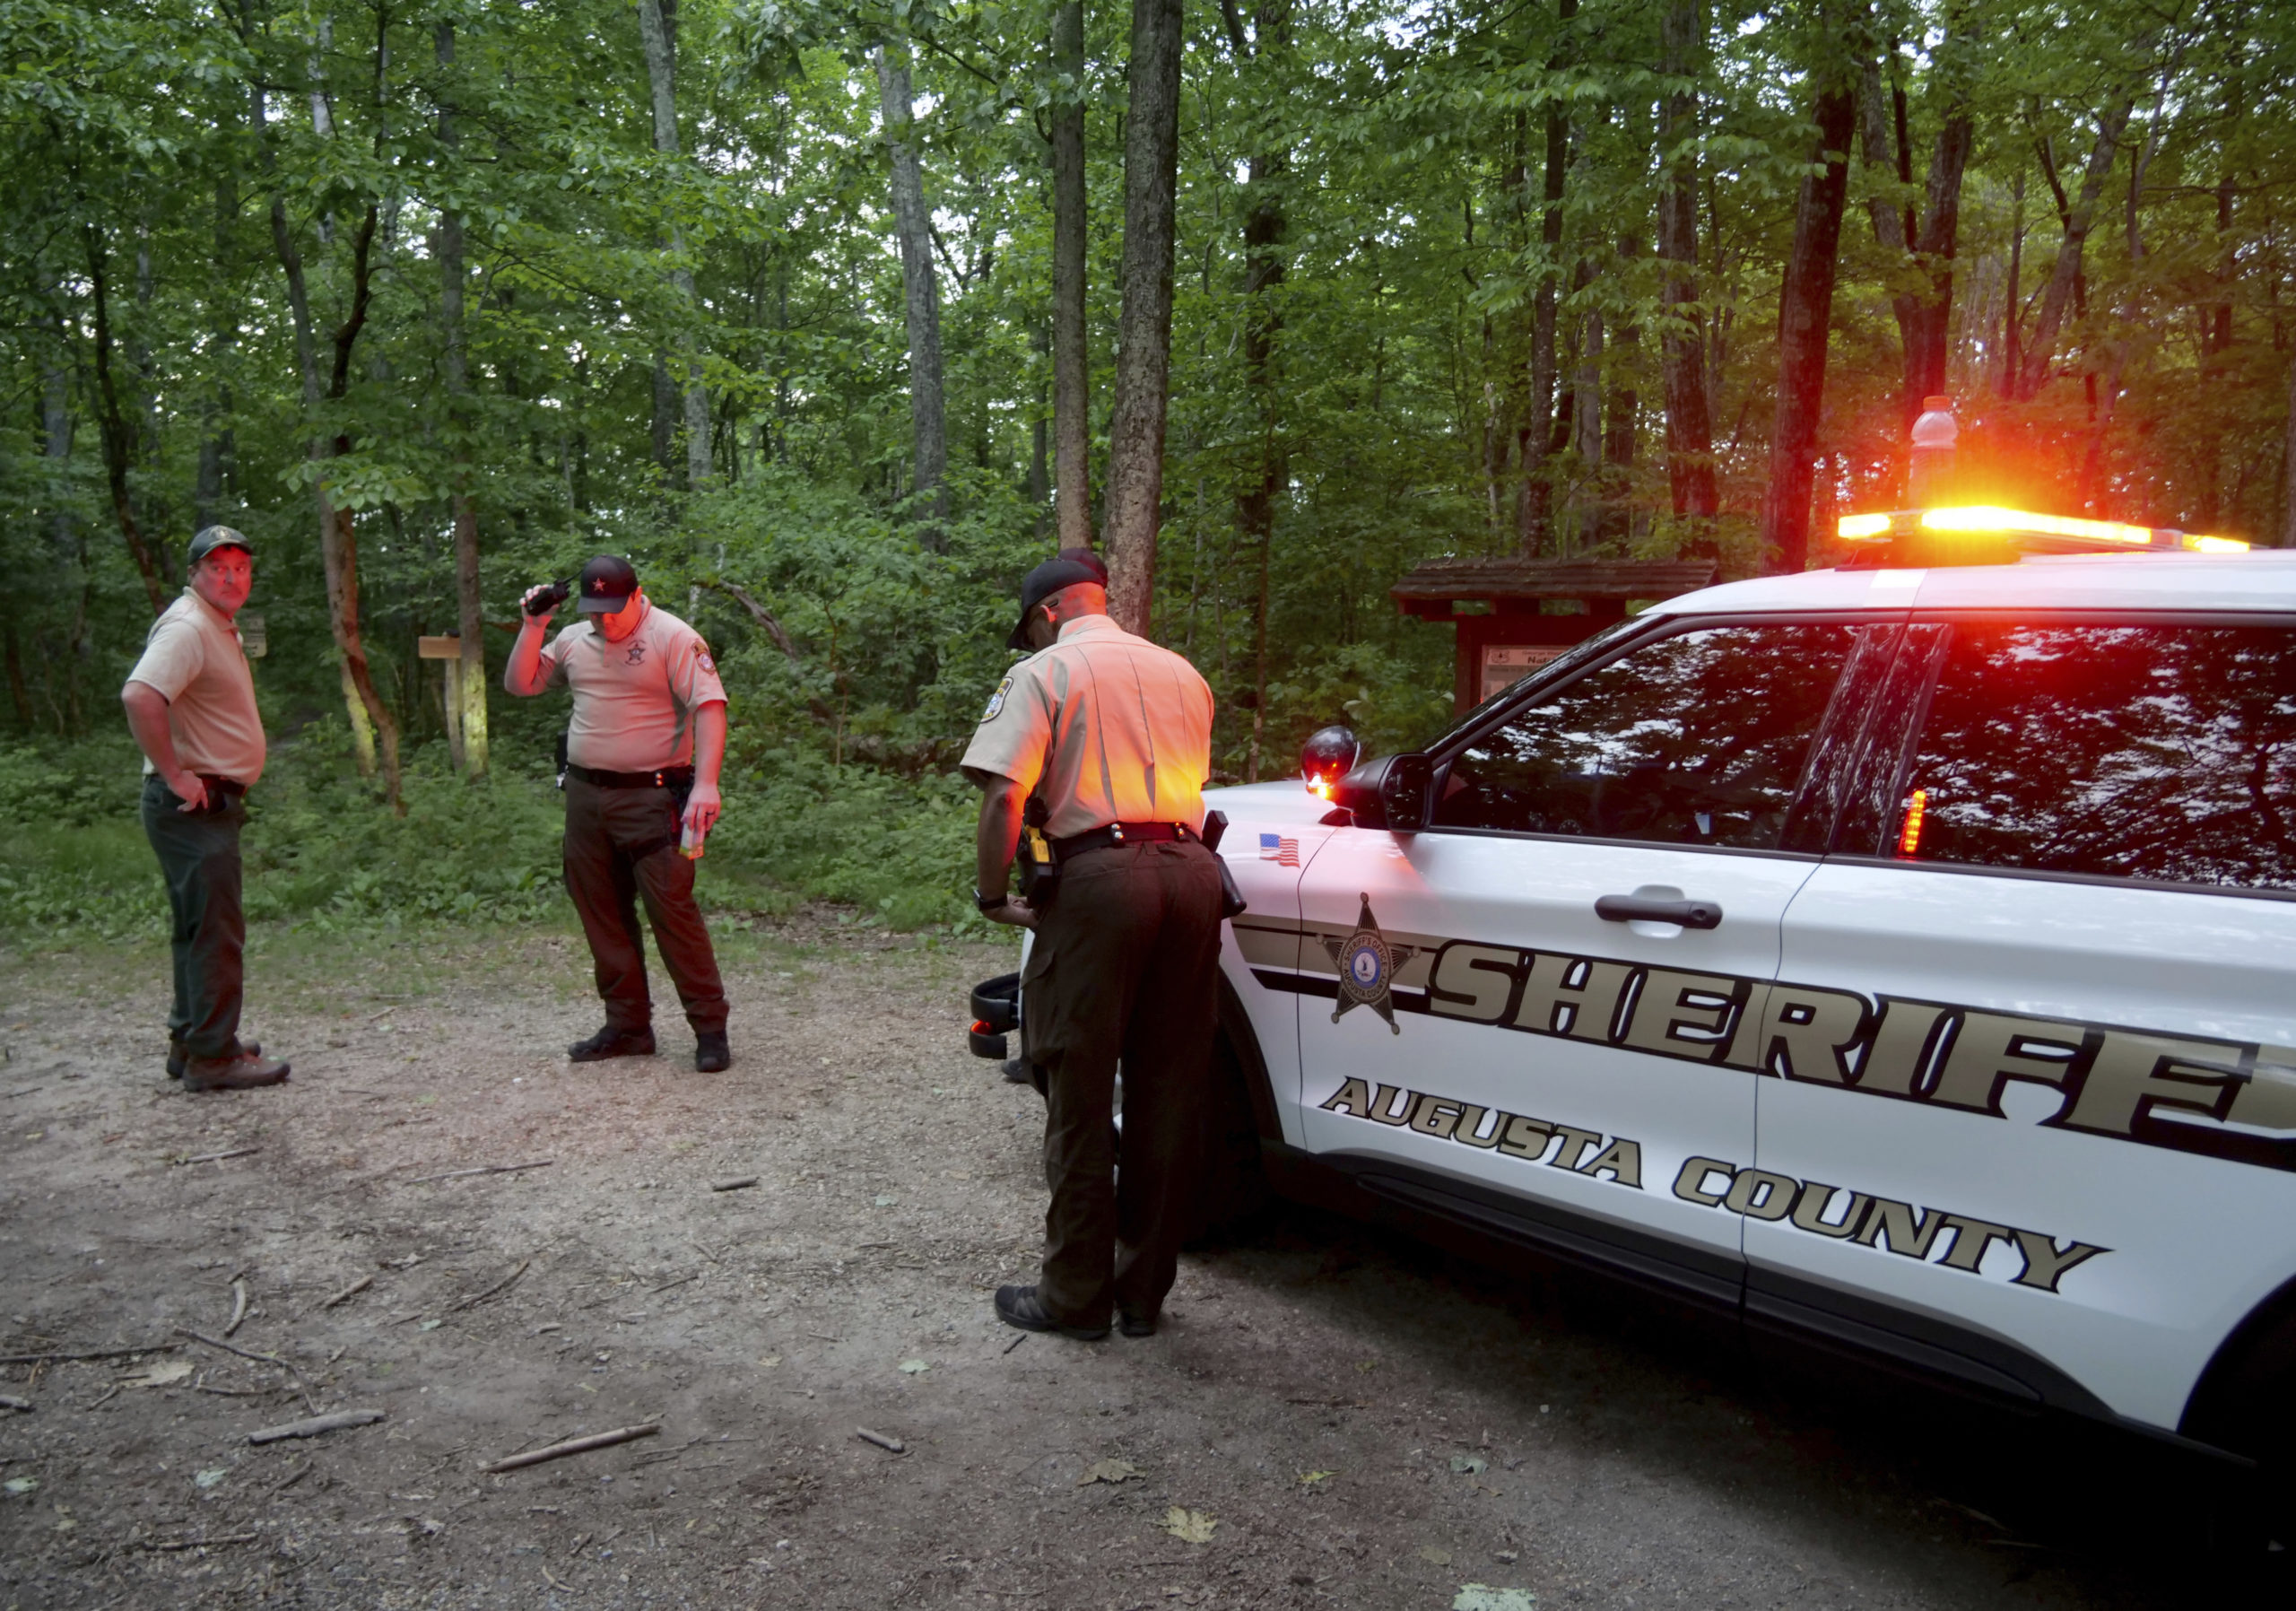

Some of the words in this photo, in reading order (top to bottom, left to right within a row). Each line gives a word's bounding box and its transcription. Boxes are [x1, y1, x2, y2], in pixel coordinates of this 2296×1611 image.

[1344, 936, 1371, 962] SHERIFF'S
[1372, 939, 1387, 967] OFFICE
[1344, 969, 1367, 997] AUGUSTA
[1429, 939, 2260, 1141] SHERIFF
[1319, 1077, 1643, 1189] AUGUSTA
[1671, 1155, 2114, 1294] COUNTY
